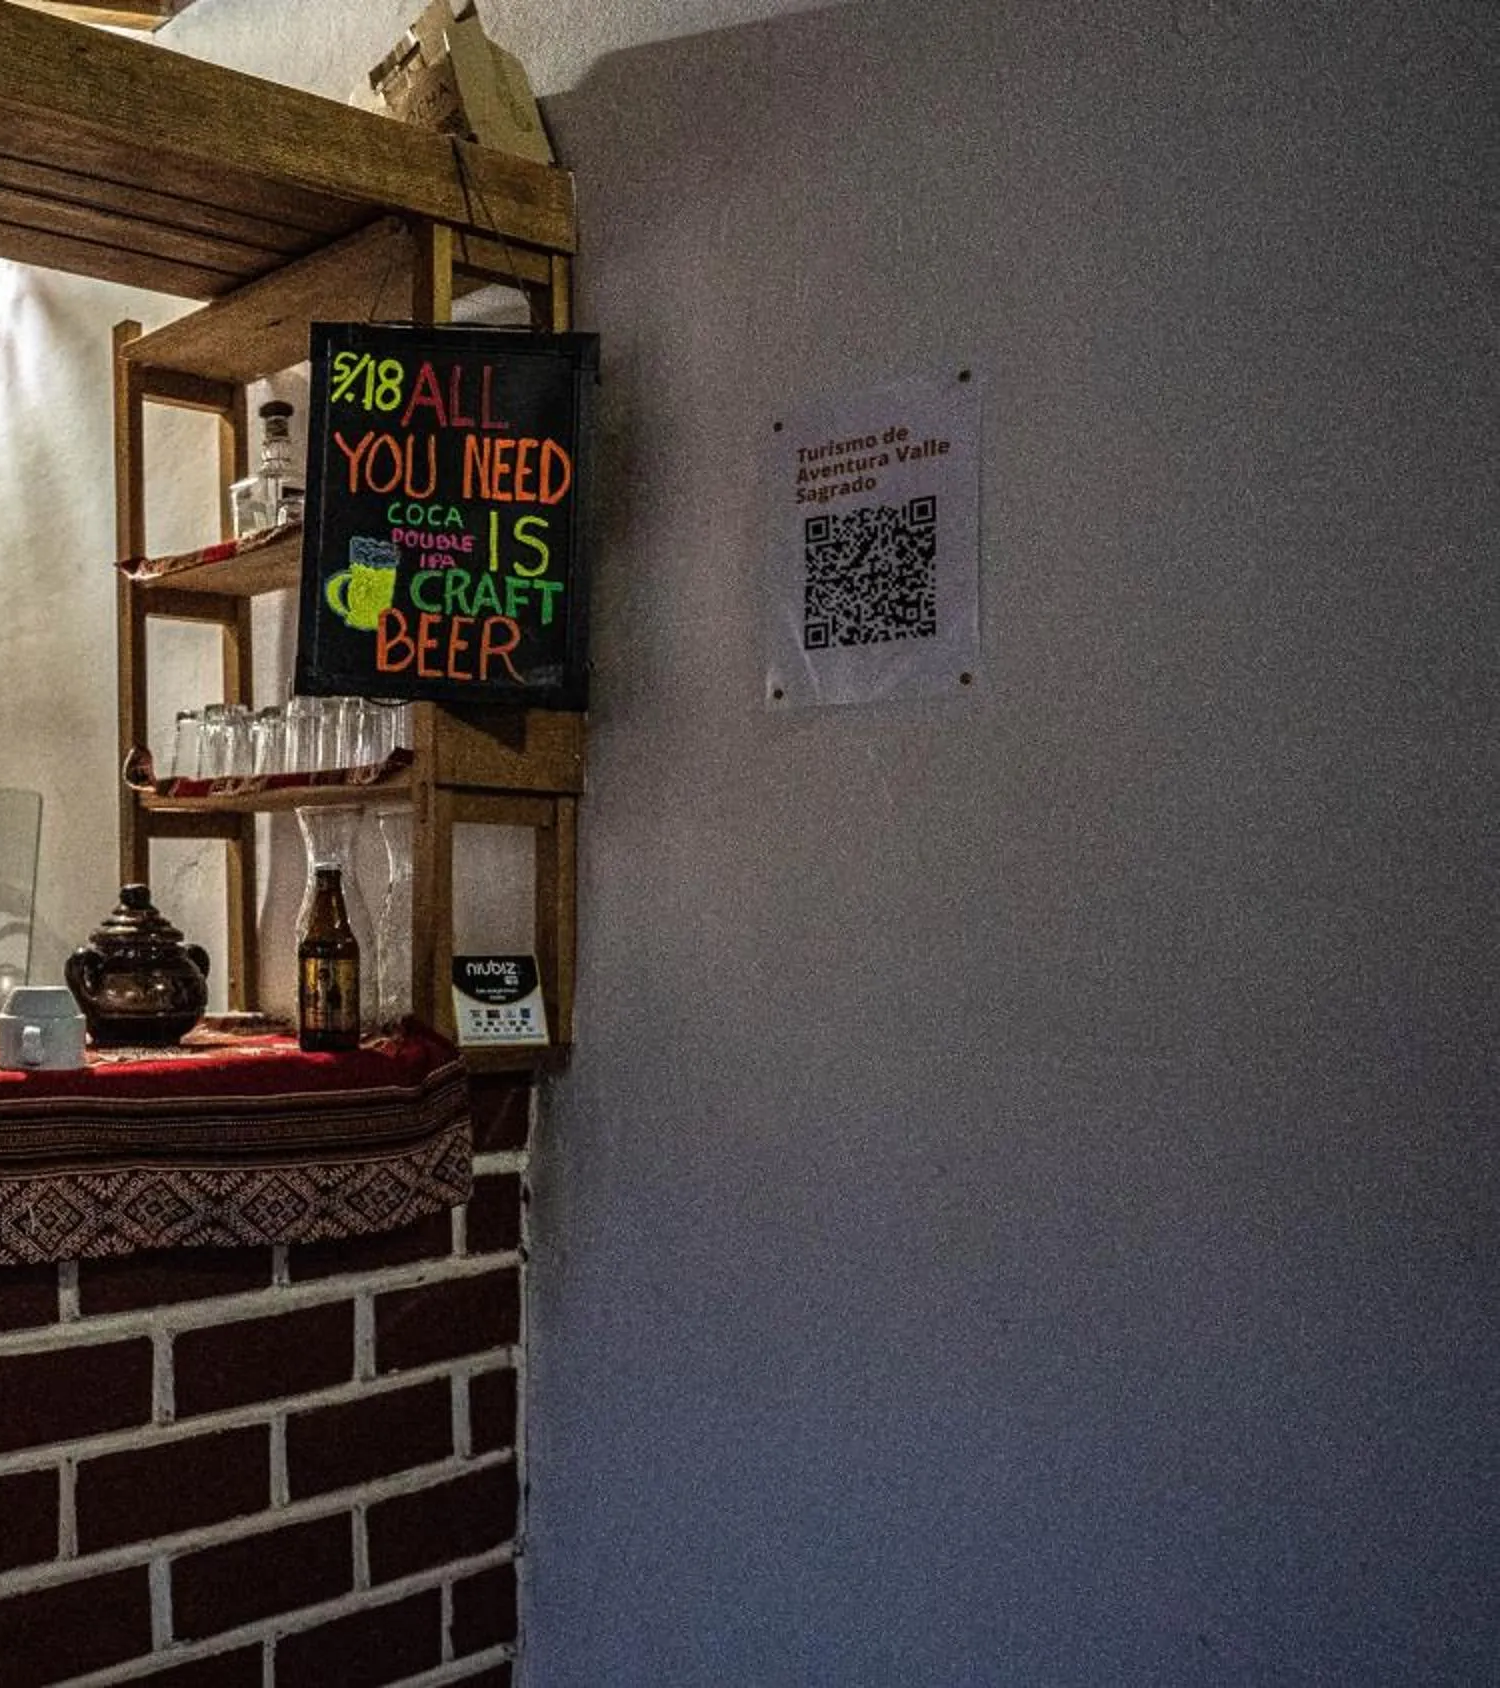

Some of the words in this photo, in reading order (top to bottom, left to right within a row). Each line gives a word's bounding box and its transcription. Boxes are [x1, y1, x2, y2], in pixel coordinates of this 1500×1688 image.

[401, 360, 510, 429] ALL
[795, 452, 889, 485] Aventura
[896, 439, 951, 463] Valle
[796, 434, 878, 463] Turismo
[883, 425, 909, 445] de
[333, 430, 437, 499] YOU
[462, 433, 572, 505] NEED
[795, 476, 877, 505] Sagrado
[386, 502, 466, 526] COCA
[391, 527, 475, 553] DOUBLE
[419, 553, 457, 569] IPA
[488, 510, 549, 577] IS
[409, 569, 564, 625] CRAFT
[376, 607, 525, 685] BEER
